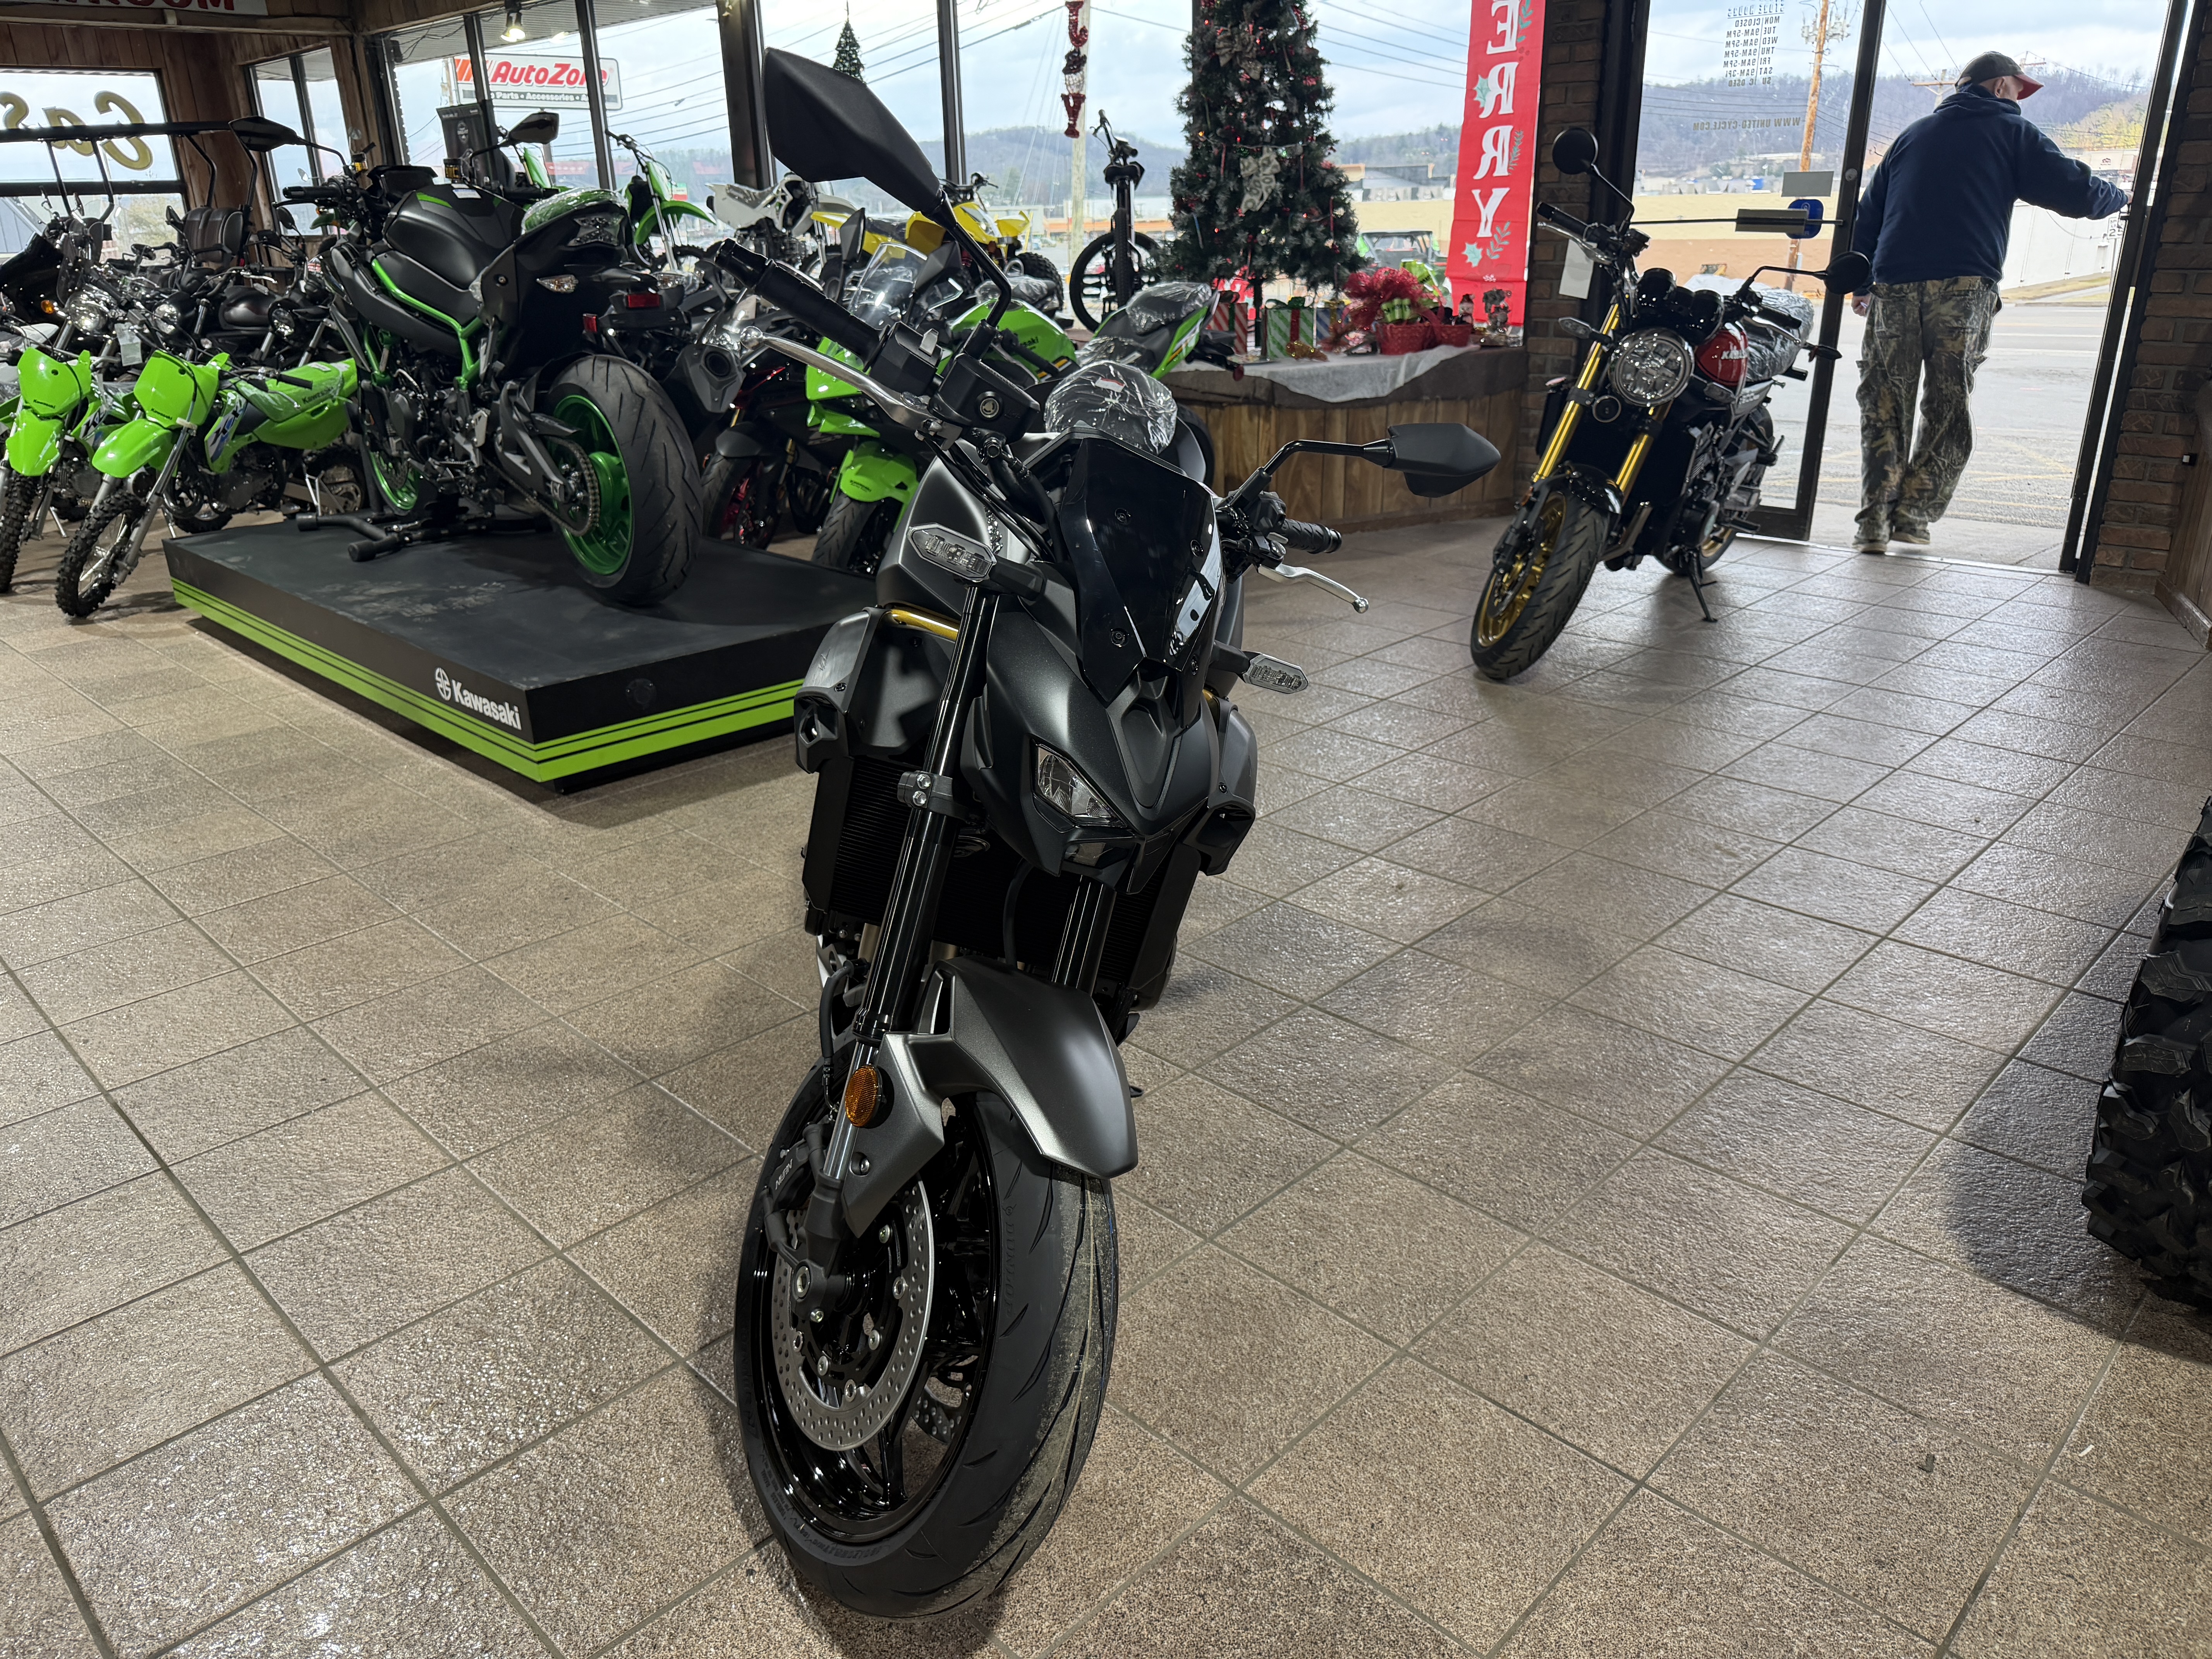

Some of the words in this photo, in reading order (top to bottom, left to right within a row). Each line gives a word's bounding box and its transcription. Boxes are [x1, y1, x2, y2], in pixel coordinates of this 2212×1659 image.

[491, 61, 608, 86] AutoZo
[452, 679, 522, 730] Kawasaki
[775, 1158, 793, 1190] NISSIN
[1004, 1222, 1015, 1318] DUNLOP
